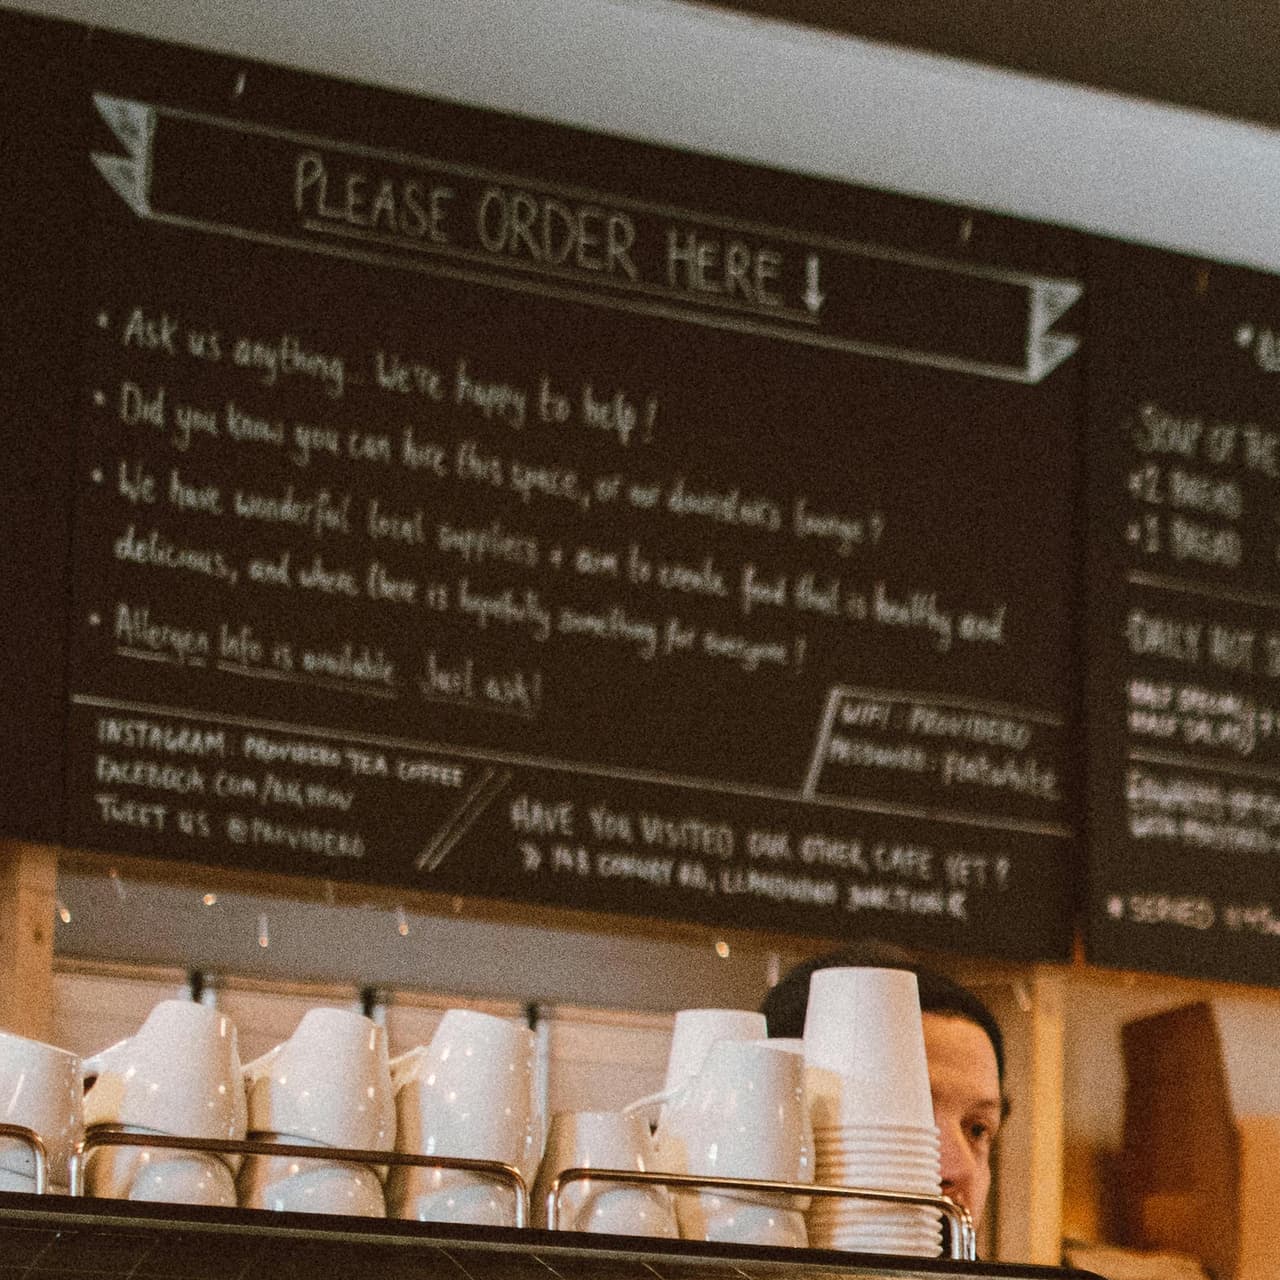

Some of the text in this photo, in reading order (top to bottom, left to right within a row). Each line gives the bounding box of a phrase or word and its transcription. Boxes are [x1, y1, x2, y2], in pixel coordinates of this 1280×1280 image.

[296, 152, 783, 307] PLEASE ORDER HERE
[123, 308, 178, 354] Ask
[190, 328, 220, 361] us
[376, 352, 441, 401] We're
[456, 358, 526, 430] happy
[540, 374, 571, 423] to
[121, 381, 165, 428] Did
[174, 405, 218, 451] you
[228, 403, 284, 446] know
[296, 424, 339, 467] you
[349, 433, 391, 465] can
[403, 426, 447, 477] hire
[457, 438, 500, 486] this
[510, 464, 591, 511] space,
[598, 477, 621, 503] or
[629, 484, 660, 508] our
[113, 522, 238, 585] delicious,
[248, 553, 292, 588] and
[301, 555, 360, 598] where
[368, 560, 417, 602] there
[427, 586, 449, 611] is
[459, 577, 551, 642] hopefully
[558, 605, 658, 660] something
[664, 616, 696, 656] for
[118, 461, 155, 504] We
[169, 468, 222, 515] have
[235, 486, 350, 536] wonderful
[368, 500, 424, 545] local
[438, 522, 538, 567] suppliers
[576, 551, 619, 577] aim
[629, 543, 652, 584] to
[743, 562, 786, 616] food
[796, 572, 842, 618] that
[844, 590, 869, 620] is
[874, 578, 953, 653] healthy
[958, 600, 1006, 646] and
[115, 602, 209, 666] Allergen
[219, 622, 263, 665] Info
[272, 638, 294, 670] is
[95, 794, 168, 830] TWEET
[178, 811, 211, 838] US
[510, 797, 573, 838] HAVE
[589, 806, 633, 844] YOU
[639, 813, 736, 857] VISITED
[746, 831, 792, 860] OUR
[800, 830, 870, 871] OTHER
[873, 840, 934, 881] CAFE
